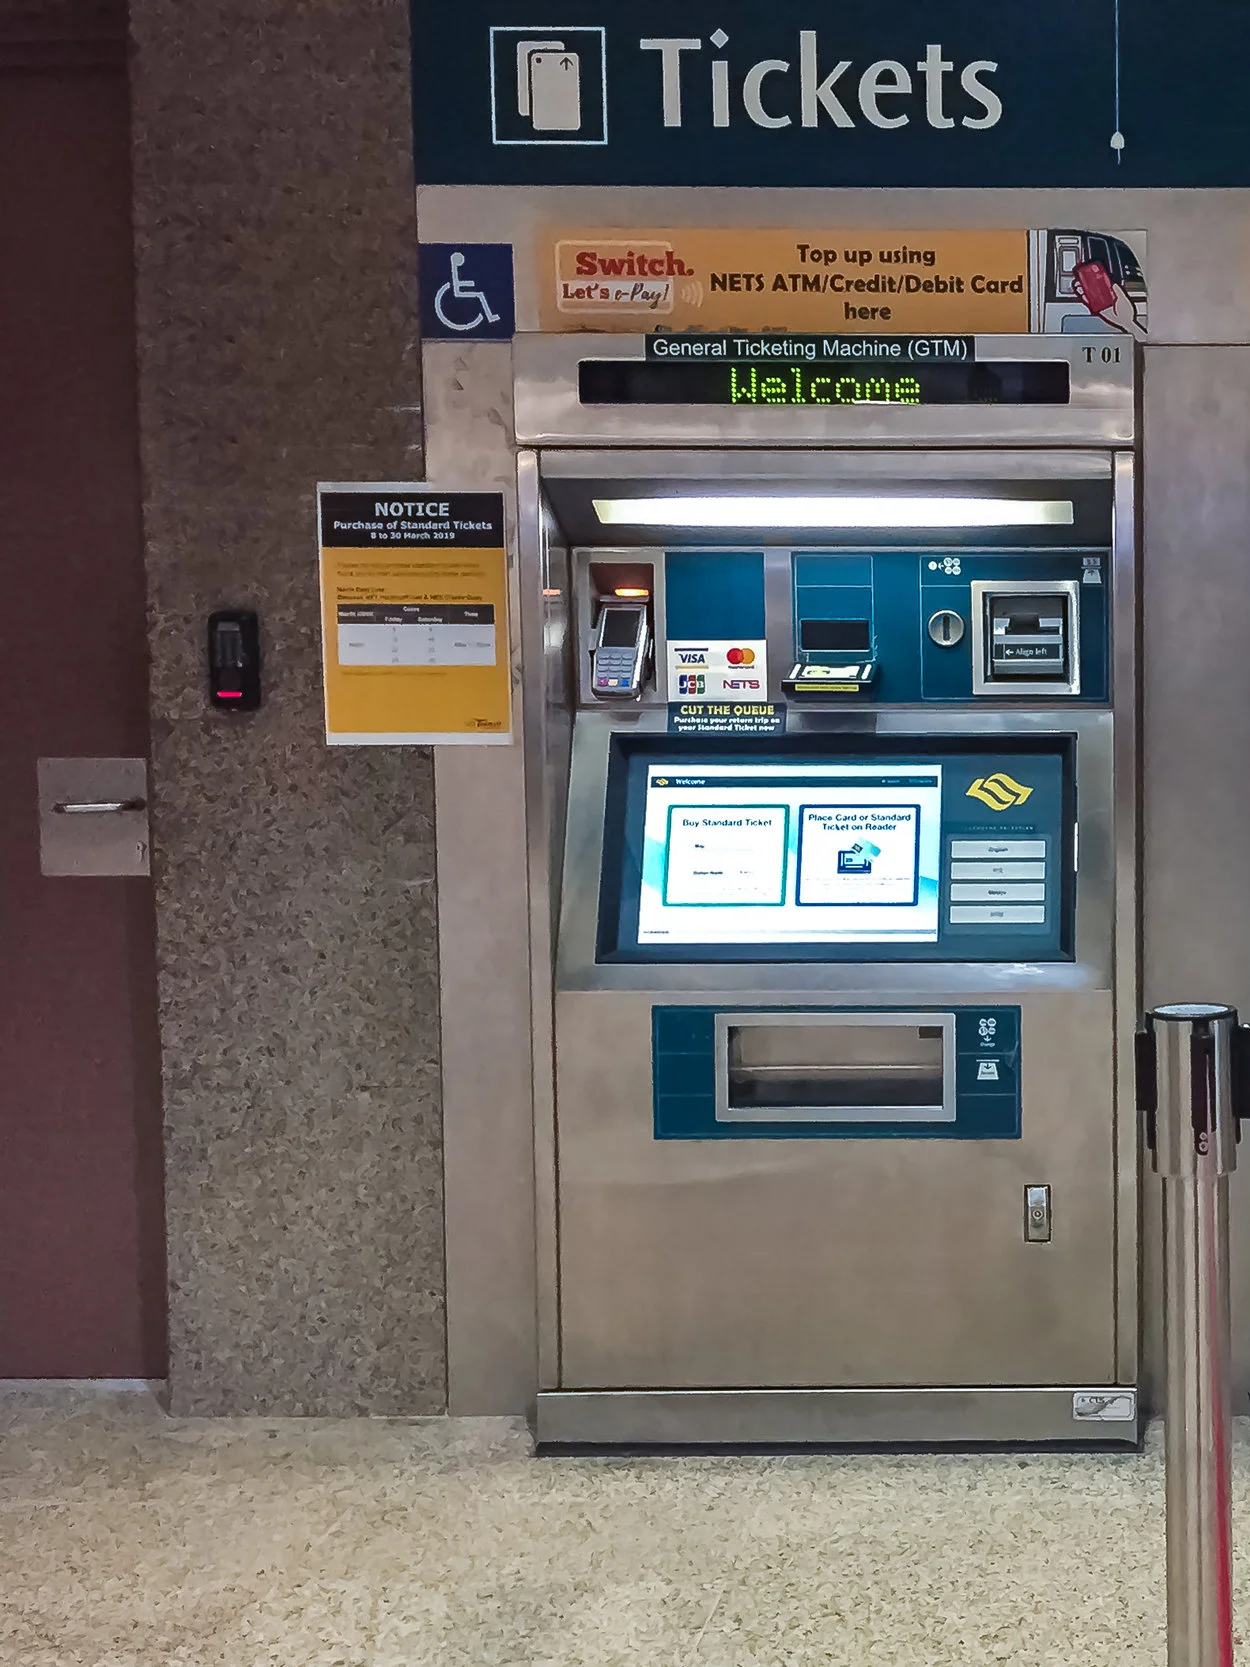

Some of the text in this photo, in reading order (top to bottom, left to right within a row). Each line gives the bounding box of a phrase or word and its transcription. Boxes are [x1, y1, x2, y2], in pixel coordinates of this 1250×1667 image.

[640, 29, 1002, 130] Tickets
[797, 244, 936, 267] Top up using
[576, 251, 694, 278] Switch.
[710, 273, 1024, 295] NETS ATM/Credit/Debit Card
[563, 283, 609, 300] Let's
[844, 301, 892, 321] here
[653, 339, 968, 360] General Ticketing Machine (GTM)
[1082, 346, 1121, 364] T 01
[730, 367, 920, 404] Welcome
[375, 502, 450, 517] NOTICE
[334, 520, 493, 530] Purchase of Standard Tickets
[379, 532, 388, 540] to
[433, 531, 455, 540] 2019
[679, 653, 705, 664] VISA
[723, 679, 760, 689] NETS
[680, 705, 774, 716] CUT THE QUEUE
[709, 717, 727, 725] your
[676, 778, 705, 786] Welcome
[682, 818, 772, 828] Buy Standard Ticket
[808, 814, 832, 822] Place
[835, 814, 857, 822] Card
[871, 814, 911, 822] Standard
[822, 823, 849, 831] Ticket
[865, 823, 897, 831] Reader
